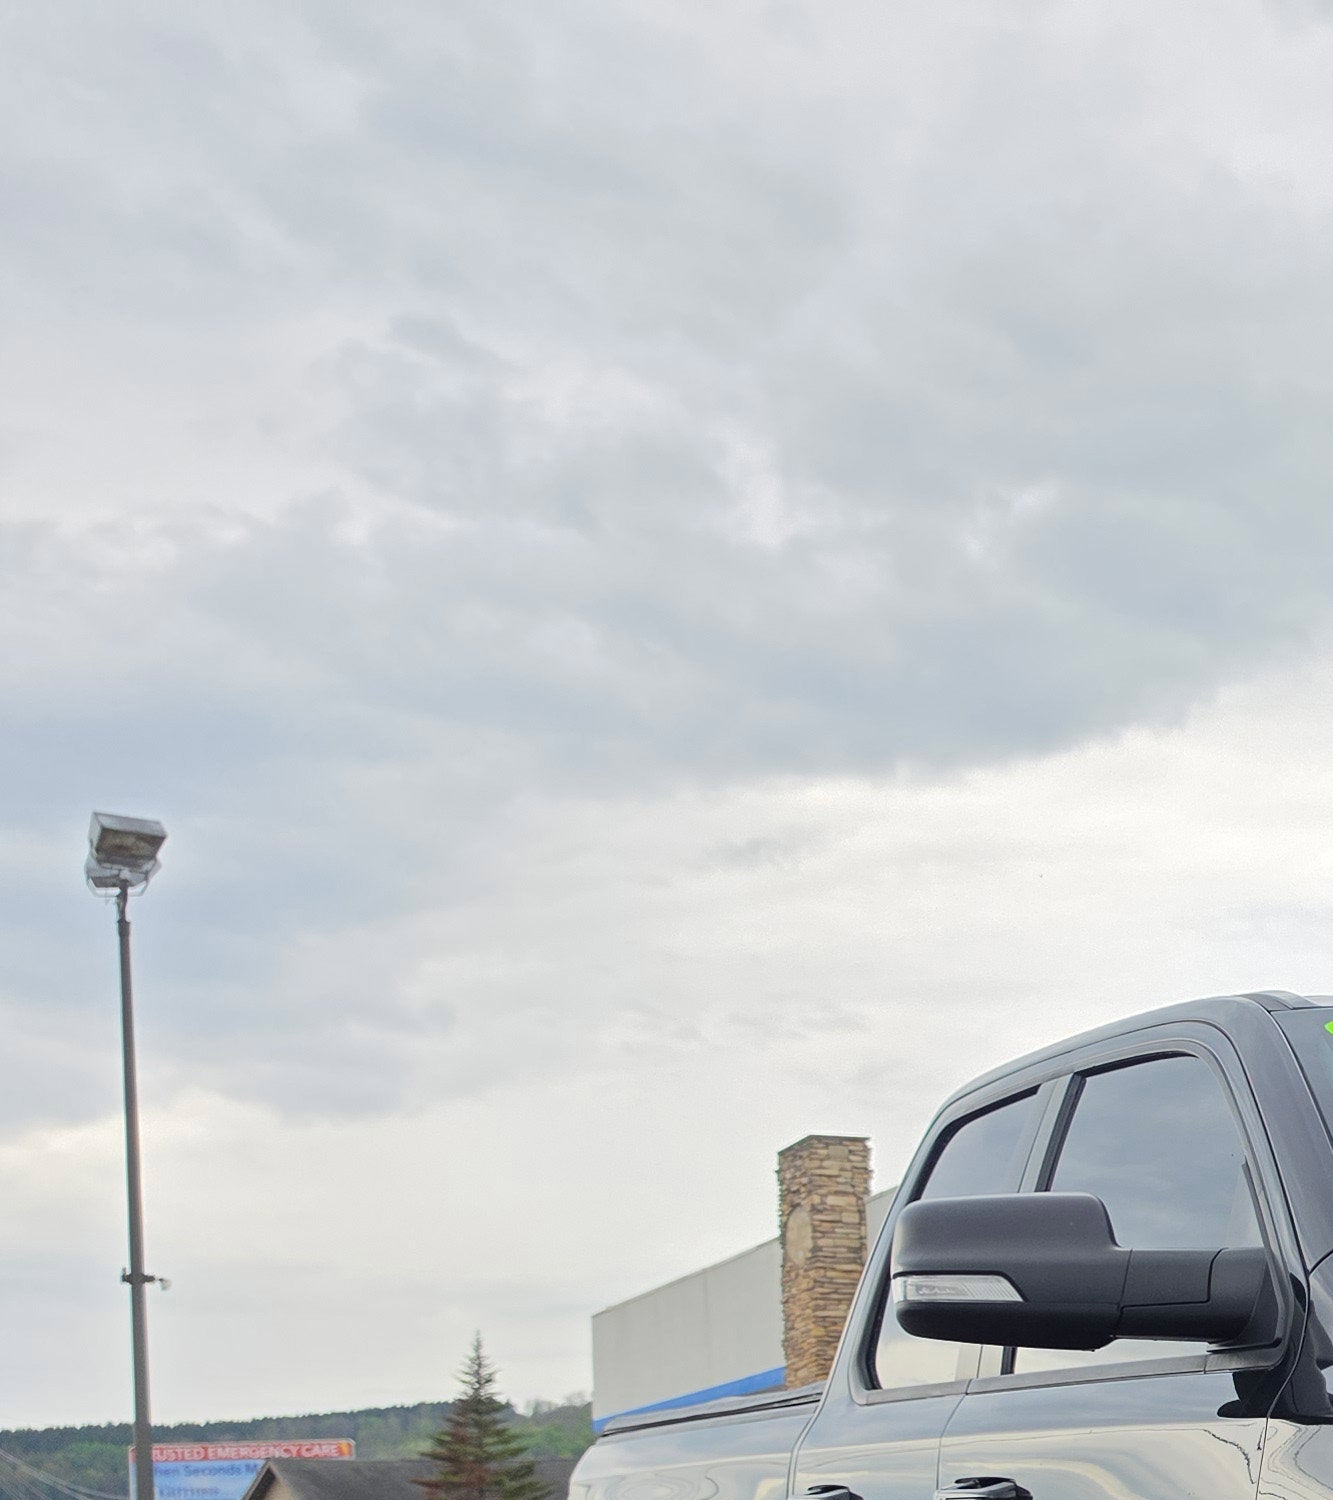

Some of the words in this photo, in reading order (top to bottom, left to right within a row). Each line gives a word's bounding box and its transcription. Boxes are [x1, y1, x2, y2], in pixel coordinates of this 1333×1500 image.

[153, 1446, 205, 1462] RUSTED
[208, 1445, 299, 1459] EMERGENCY
[302, 1443, 339, 1458] CARE
